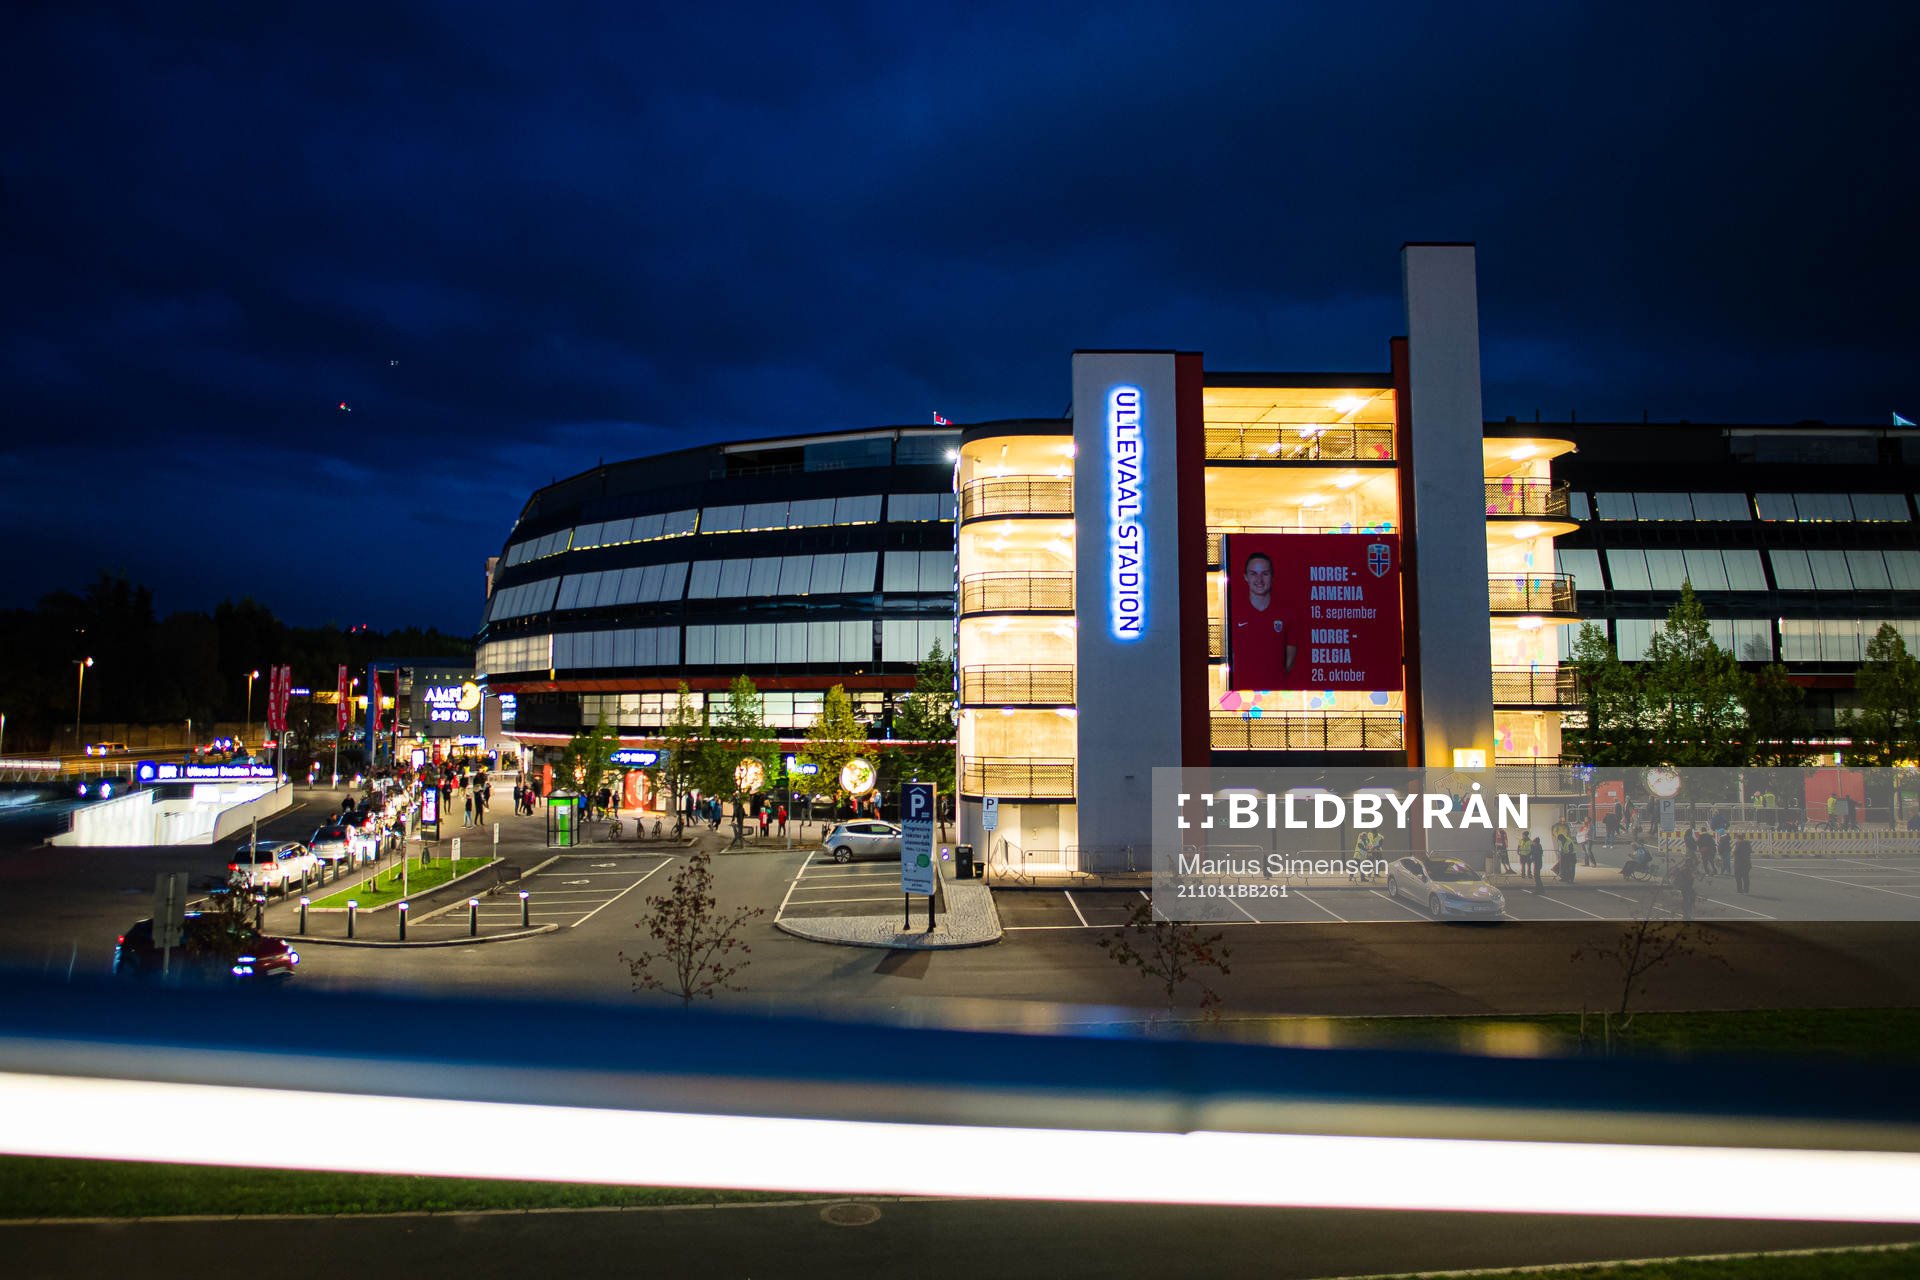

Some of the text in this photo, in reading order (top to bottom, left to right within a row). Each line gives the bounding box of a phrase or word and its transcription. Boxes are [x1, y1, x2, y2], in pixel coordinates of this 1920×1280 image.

[1116, 392, 1140, 633] ULLEVAAL STADION
[1309, 566, 1349, 581] NORGE
[1310, 586, 1364, 601] ARMENIA
[1310, 605, 1377, 621] 16. september
[1311, 628, 1350, 644] NORGE
[1311, 648, 1352, 664] BELGIA
[1311, 668, 1366, 682] 26. oktober
[911, 794, 925, 817] P
[986, 798, 995, 810] P
[1663, 800, 1671, 812] P
